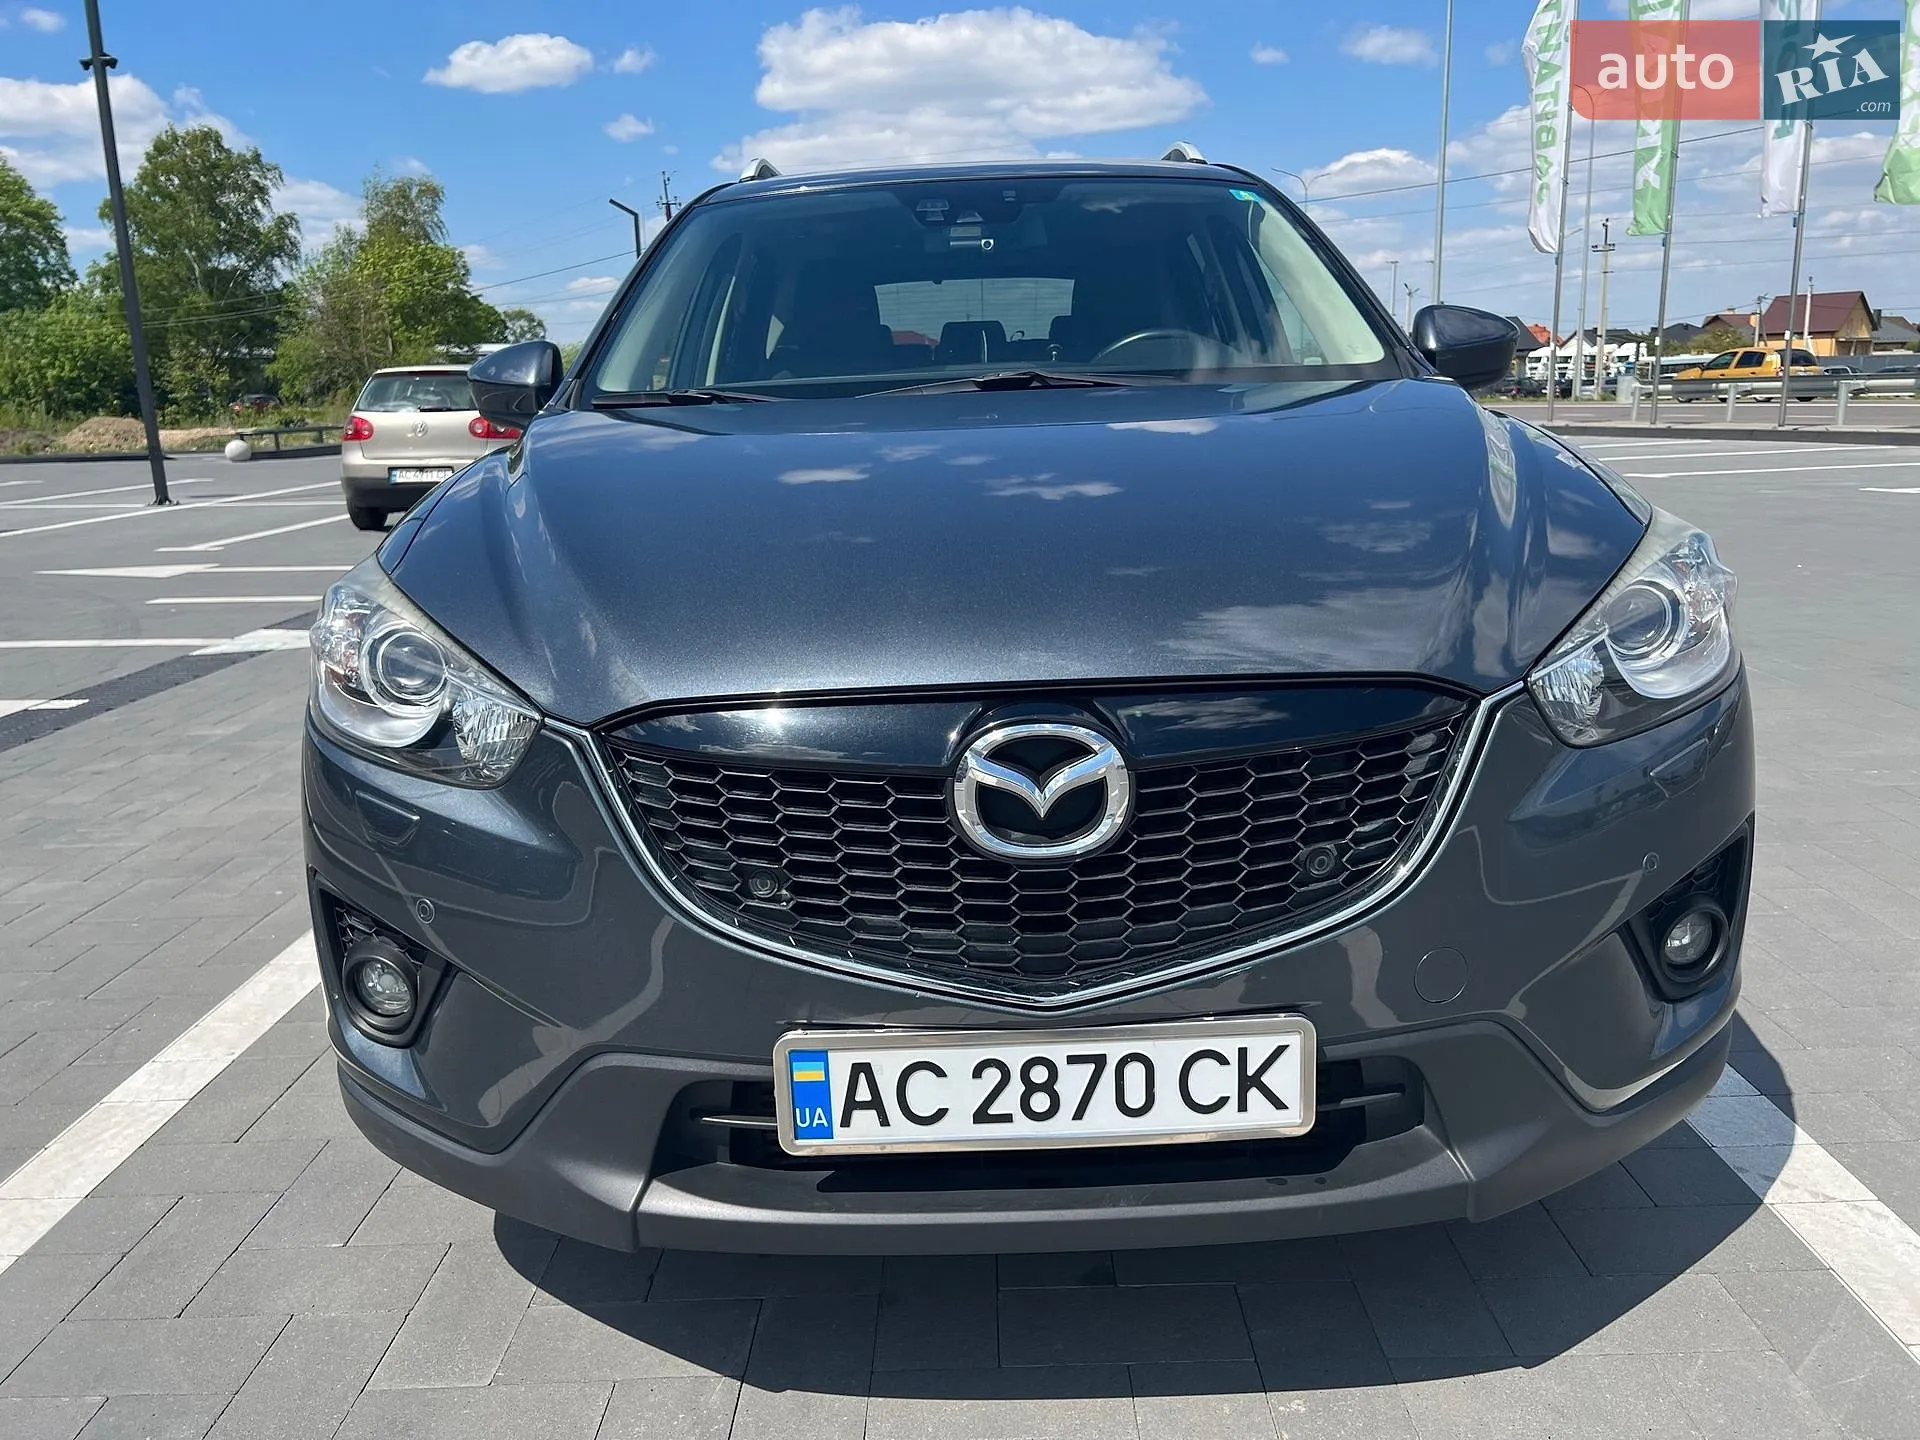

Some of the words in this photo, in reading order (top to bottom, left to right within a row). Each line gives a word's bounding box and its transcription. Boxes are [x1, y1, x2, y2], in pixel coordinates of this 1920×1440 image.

[839, 1060, 950, 1128] AC
[971, 1051, 1156, 1124] 2870
[1178, 1044, 1291, 1114] CK
[795, 1107, 828, 1128] UA
